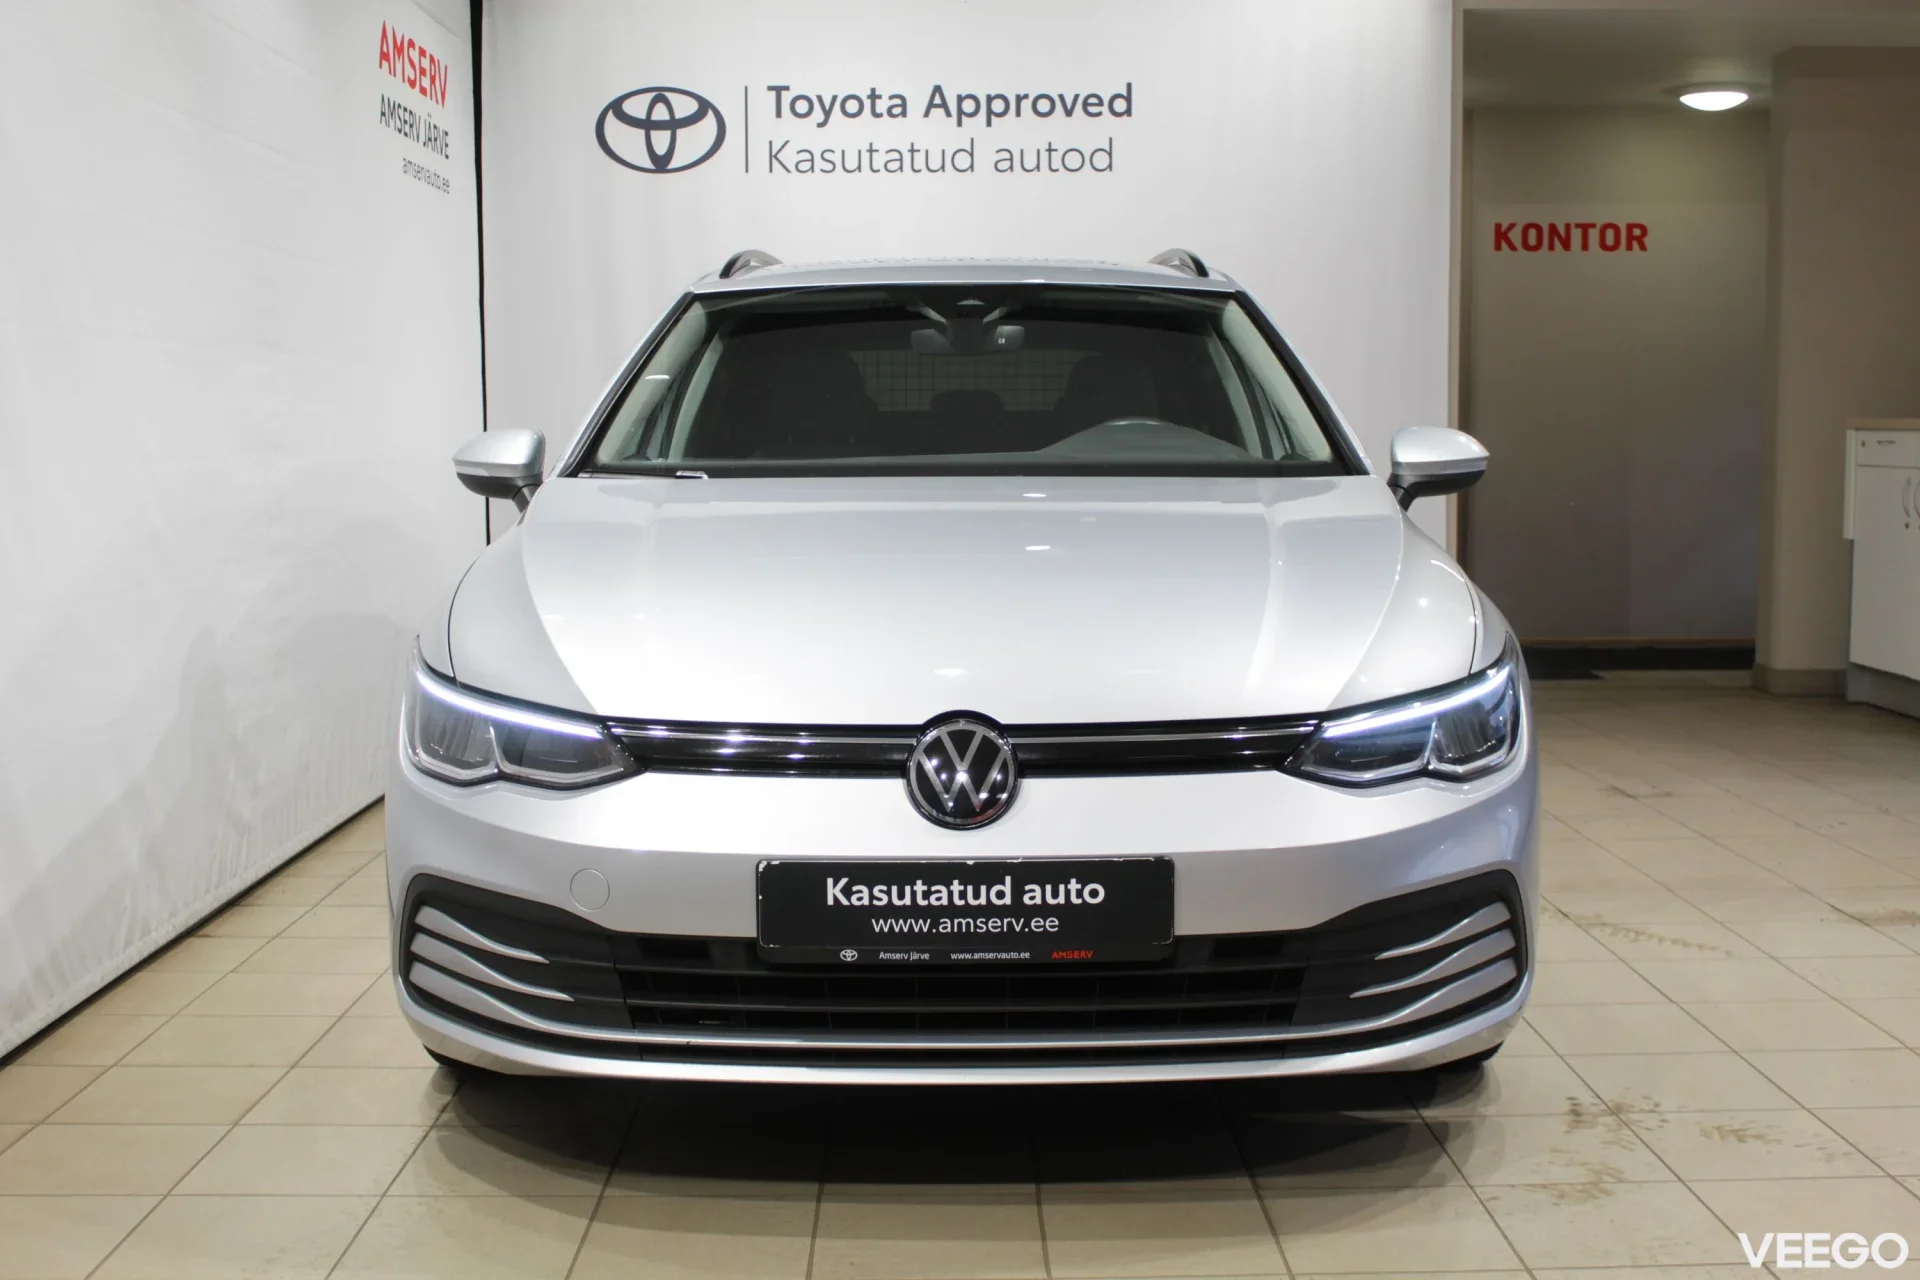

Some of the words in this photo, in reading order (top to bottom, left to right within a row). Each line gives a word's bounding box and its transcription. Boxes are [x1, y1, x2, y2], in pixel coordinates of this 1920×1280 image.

[378, 19, 448, 109] AMSERV
[766, 85, 908, 128] Toyota
[922, 82, 1133, 128] Approved
[380, 93, 421, 144] AMSERV
[423, 112, 450, 160] JÄRVE
[767, 137, 975, 174] Kasutatud
[993, 137, 1114, 174] autod
[402, 157, 450, 194] amservauto.ee
[1493, 222, 1649, 252] KONTOR
[826, 876, 1012, 906] Kasutatud
[1022, 877, 1105, 906] auto
[871, 917, 1060, 933] www.amserv.ee
[879, 951, 908, 960] Amserv
[910, 951, 930, 961] Järve
[950, 951, 1031, 960] www.amservauto.ee
[1051, 950, 1094, 959] AMSERV
